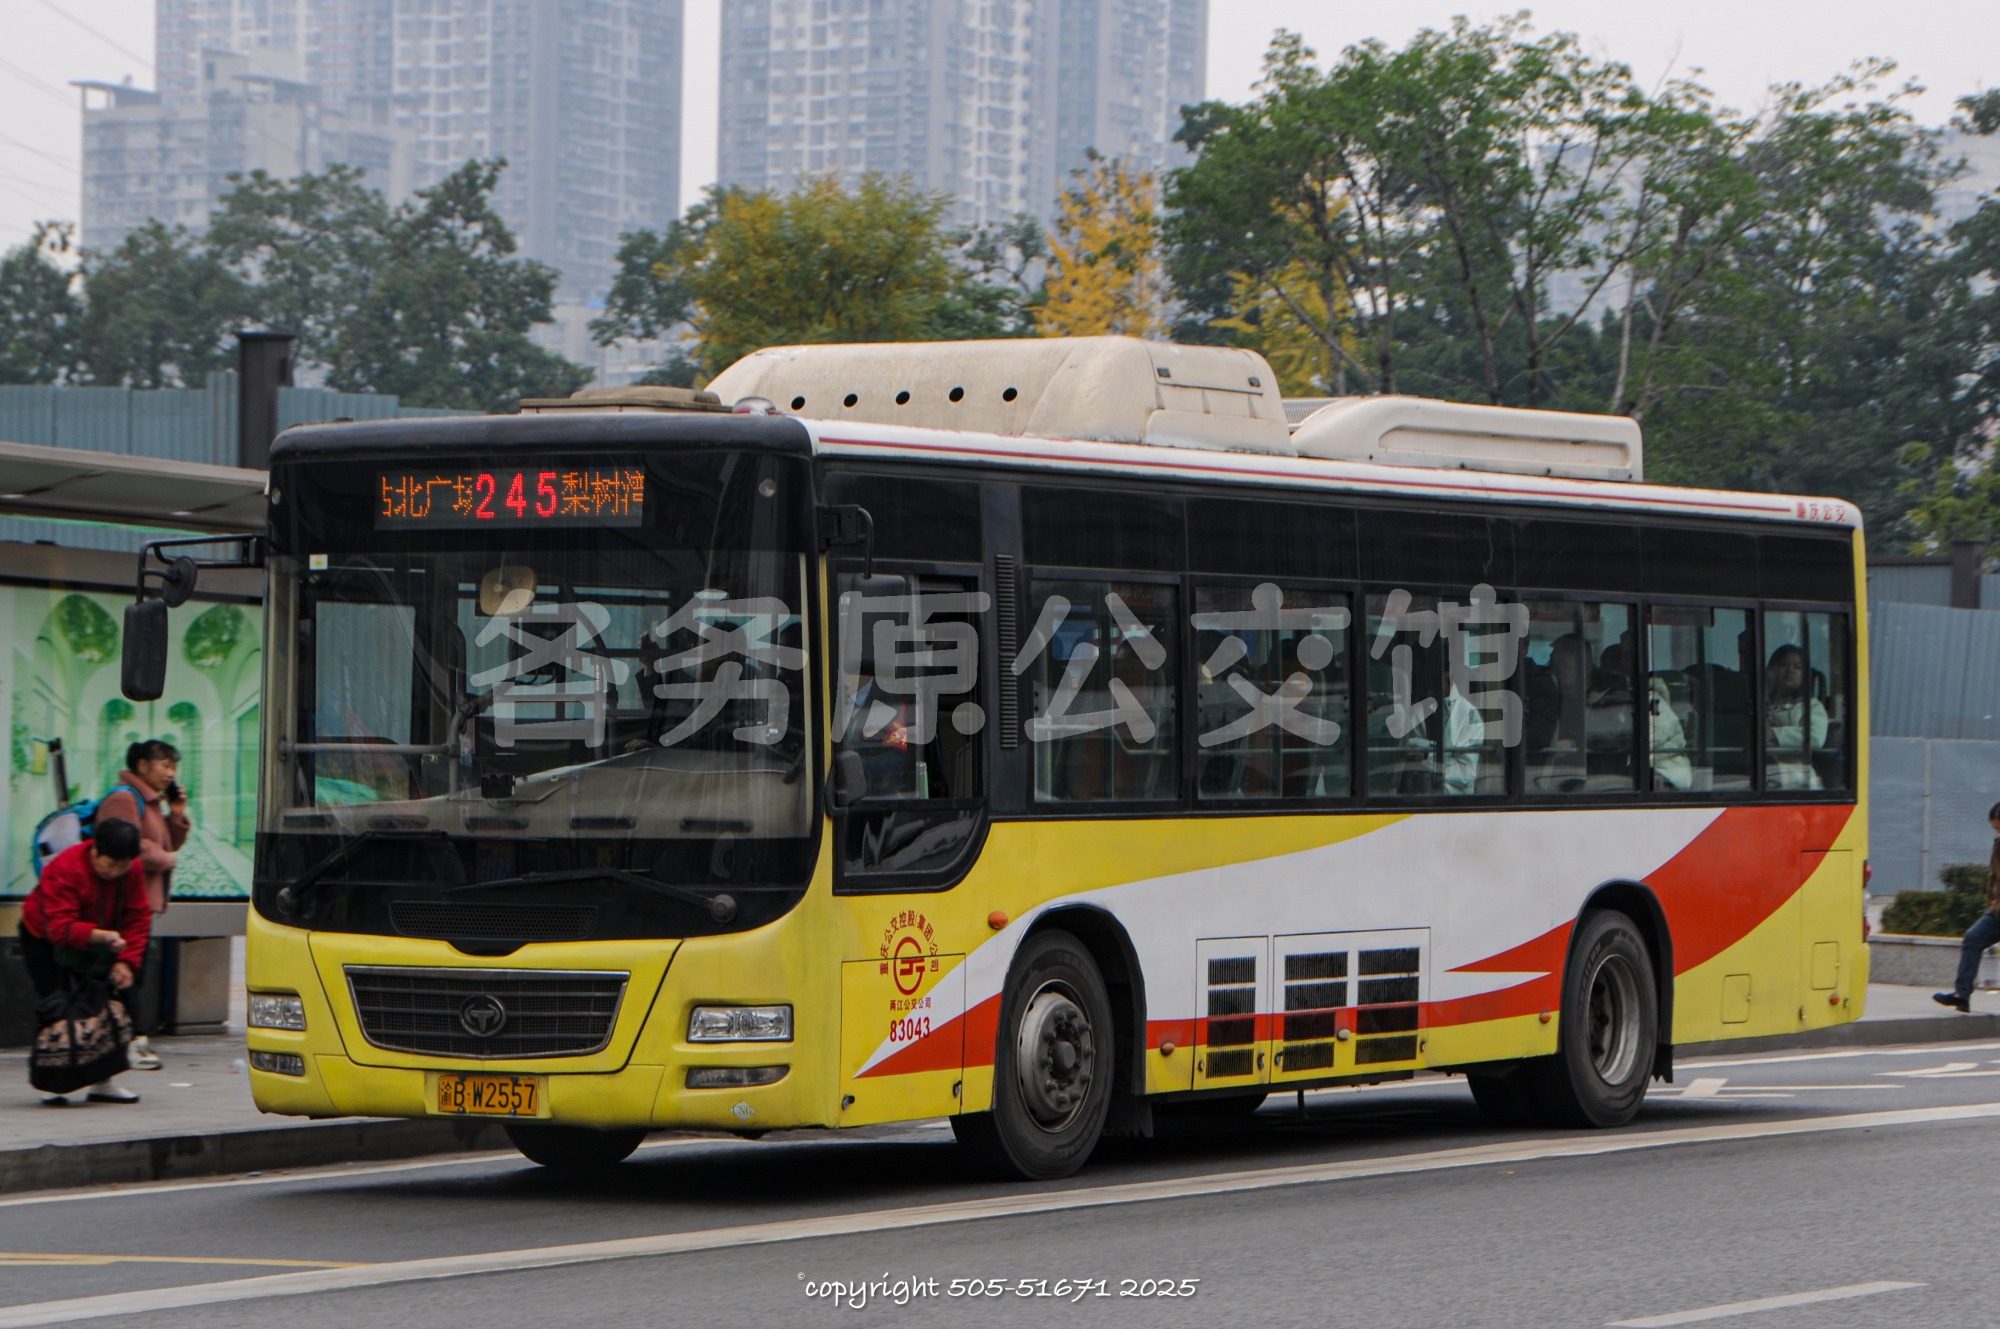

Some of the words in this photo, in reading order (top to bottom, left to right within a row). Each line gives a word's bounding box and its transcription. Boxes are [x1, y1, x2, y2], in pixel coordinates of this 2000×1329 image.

[381, 475, 474, 518] 北广场
[476, 472, 557, 519] 245
[889, 1016, 931, 1042] 83043
